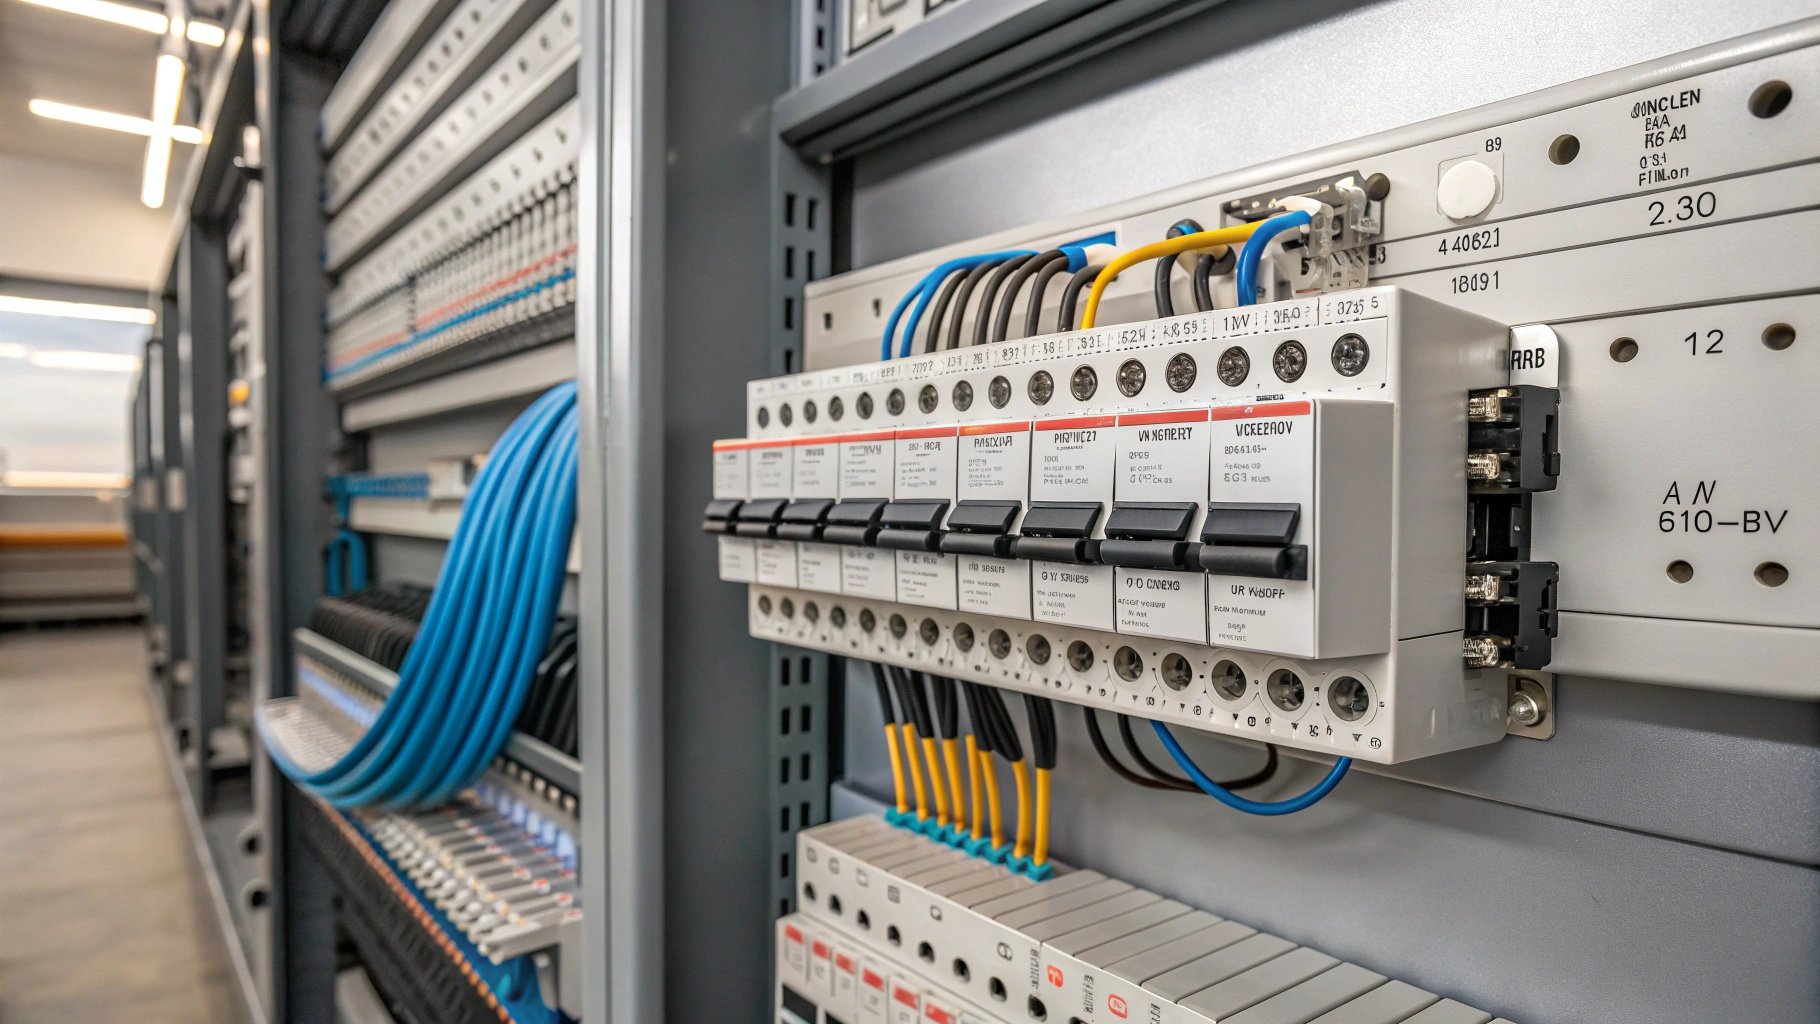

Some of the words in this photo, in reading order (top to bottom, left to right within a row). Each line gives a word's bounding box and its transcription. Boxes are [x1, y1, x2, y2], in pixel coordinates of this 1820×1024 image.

[1648, 191, 1717, 227] 2.30
[1684, 329, 1725, 356] 12
[1658, 509, 1789, 534] 610-BV
